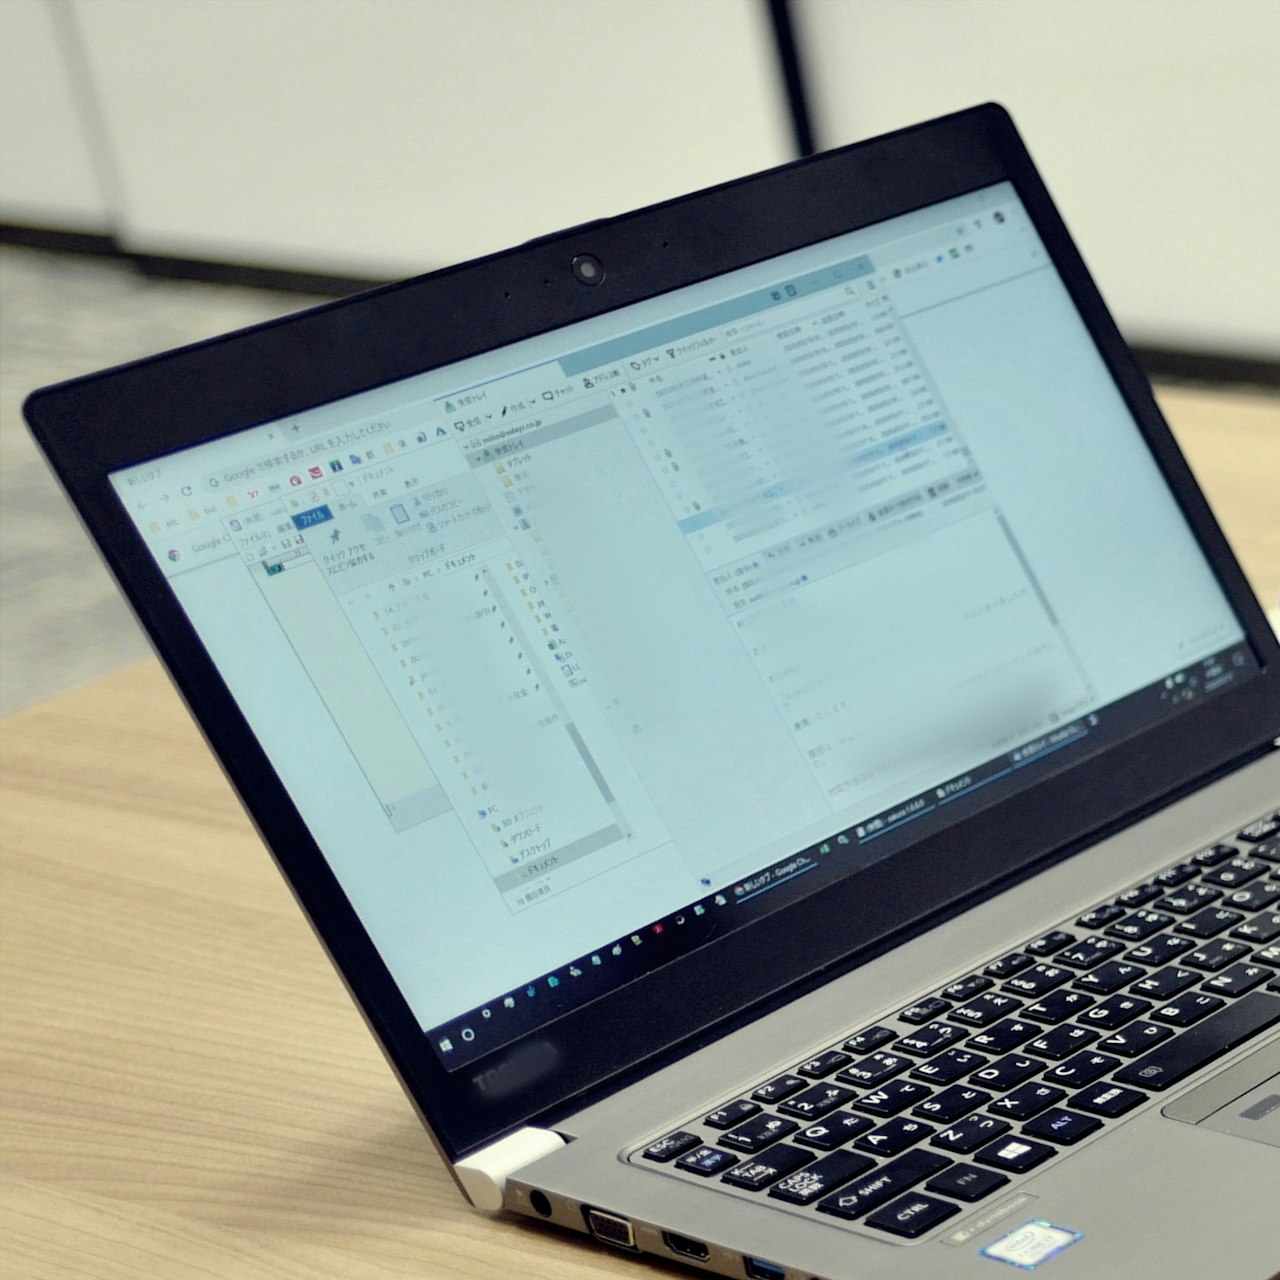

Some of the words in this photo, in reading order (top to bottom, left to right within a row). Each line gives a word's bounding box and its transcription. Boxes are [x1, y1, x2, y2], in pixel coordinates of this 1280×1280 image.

[223, 466, 256, 482] Google
[191, 537, 223, 553] Google
[444, 553, 476, 570] ドキュメント
[1238, 924, 1258, 934] K
[1132, 946, 1152, 956] U
[1193, 952, 1207, 961] J
[1081, 974, 1099, 983] Y
[1177, 970, 1189, 978] く
[1138, 979, 1159, 990] H
[1210, 976, 1232, 987] N
[1196, 996, 1211, 1004] こ
[1028, 1003, 1047, 1012] T
[1160, 1007, 1180, 1016] B
[1088, 1008, 1109, 1018] G
[1011, 1023, 1023, 1031] す
[974, 1035, 994, 1044] R
[1033, 1039, 1047, 1049] F
[1106, 1034, 1126, 1044] V
[956, 1054, 971, 1062] い
[1090, 1056, 1105, 1064] そ
[919, 1064, 939, 1074] E
[978, 1069, 999, 1079] D
[1055, 1066, 1076, 1076] C
[900, 1084, 915, 1092] て
[861, 1091, 889, 1104] W
[962, 1091, 976, 1099] と
[923, 1102, 941, 1111] S
[997, 1098, 1019, 1108] X
[843, 1117, 859, 1126] た
[979, 1120, 994, 1128] つ
[1051, 1116, 1072, 1130] ALT
[805, 1126, 829, 1137] Q
[903, 1123, 918, 1131] ち
[867, 1135, 888, 1145] A
[939, 1130, 963, 1141] Z
[649, 1139, 674, 1153] ESC
[779, 1172, 810, 1189] CAPS
[788, 1173, 823, 1192] LOCK
[956, 1173, 978, 1185] FN
[858, 1176, 891, 1196] SHIFT
[897, 1203, 929, 1220] CTRL
